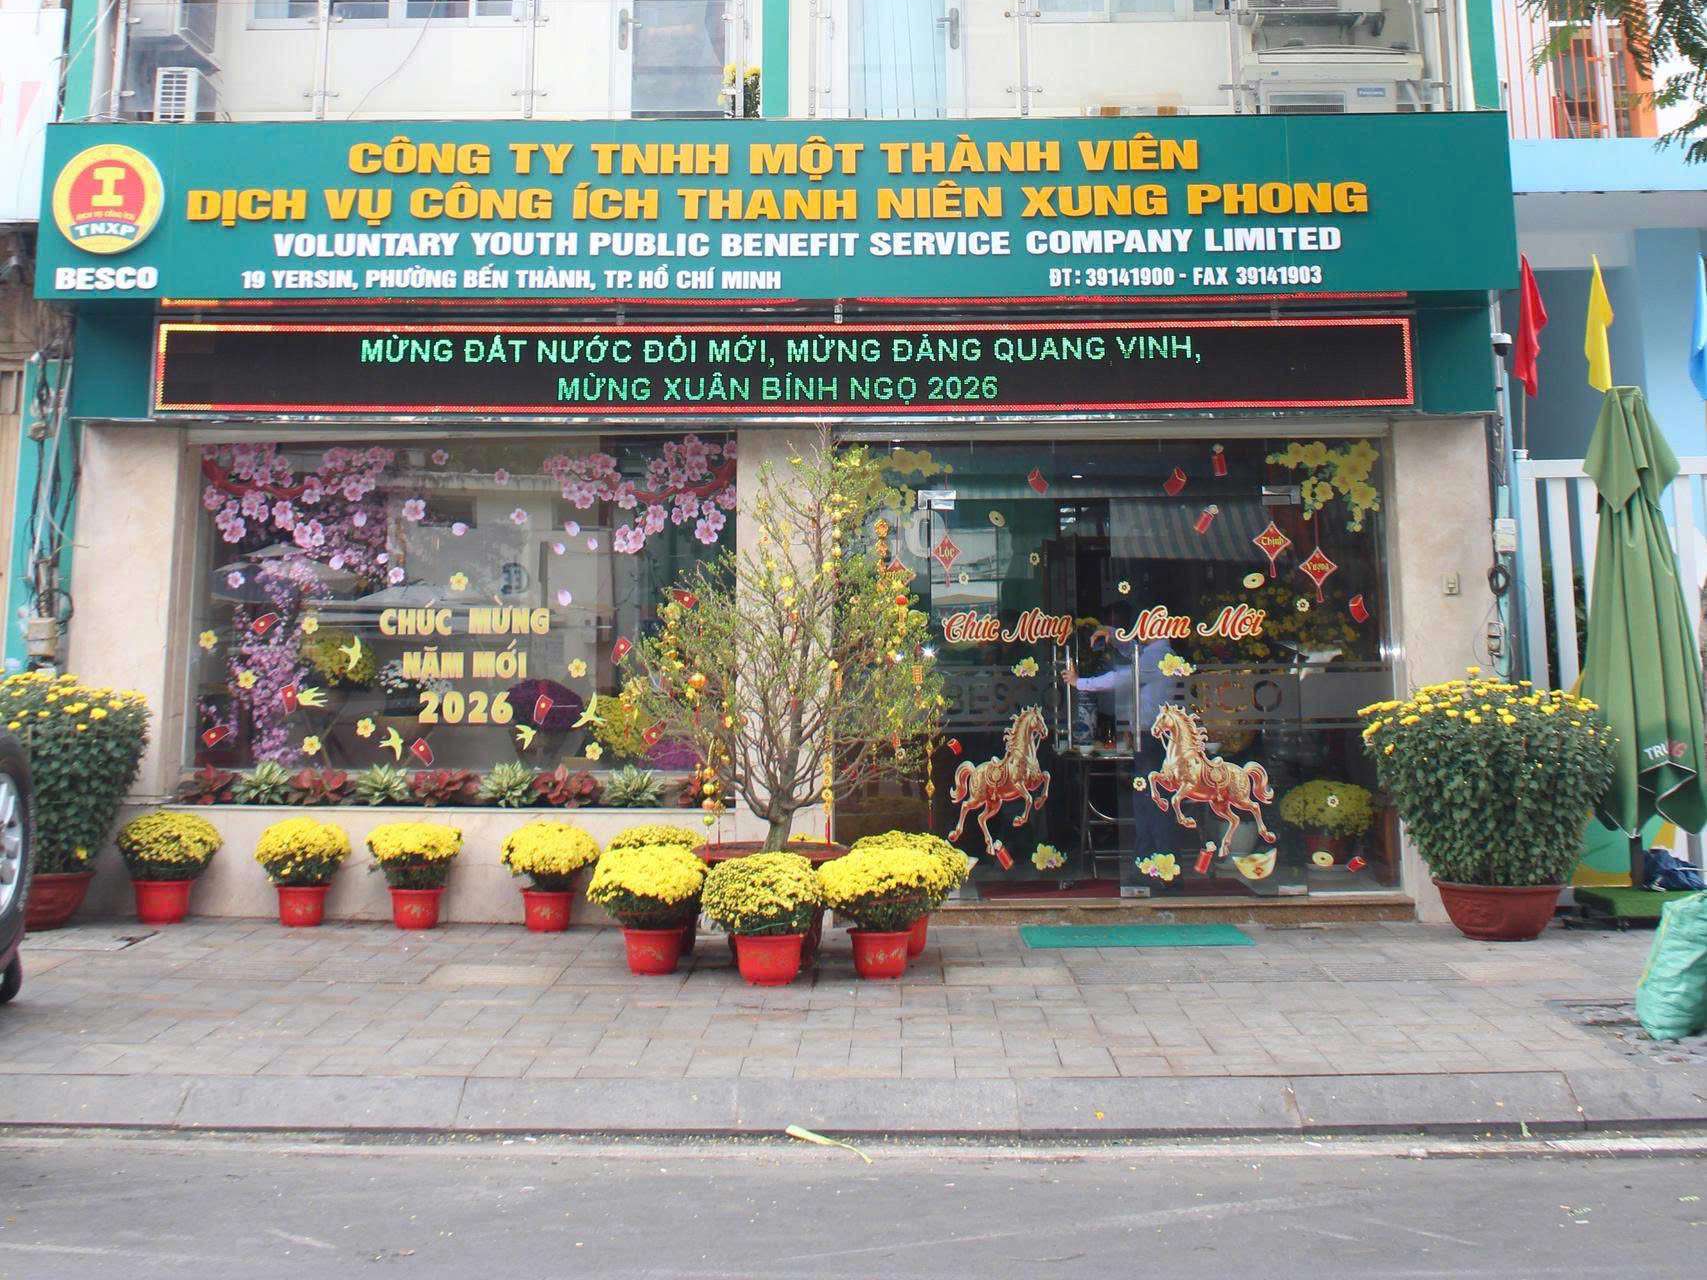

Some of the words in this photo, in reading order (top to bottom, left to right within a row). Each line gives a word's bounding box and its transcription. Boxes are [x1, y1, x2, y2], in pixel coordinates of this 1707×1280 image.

[349, 136, 490, 175] CÔNG
[511, 143, 570, 174] TY
[591, 143, 729, 174] TNHH
[750, 136, 864, 181] MỘT
[880, 134, 1060, 173] THÀNH
[1079, 132, 1199, 171] VIÊN
[187, 189, 307, 227] DỊCH
[325, 188, 392, 227] VỤ
[410, 181, 553, 220] CÔNG
[573, 182, 659, 220] ÍCH
[678, 187, 858, 220] THANH
[877, 180, 1002, 220] NIÊN
[1022, 184, 1168, 218] XUNG
[1187, 181, 1369, 215] PHONG
[74, 222, 136, 237] TNXP
[273, 232, 460, 258] VOLUNTARY
[470, 231, 579, 257] YOUTH
[589, 232, 711, 257] PUBLIC
[721, 232, 860, 257] BENEFIT
[869, 231, 1011, 256] SERVICE
[1026, 228, 1193, 255] COMPANY
[1205, 226, 1342, 252] LIMITED
[55, 266, 159, 291] BESCO
[241, 270, 265, 289] 19
[272, 269, 359, 292] YERSIN,
[365, 265, 457, 289] PHƯỜNG
[463, 263, 509, 289] BẾN
[515, 266, 596, 292] THÀNH,
[603, 270, 633, 289] TP.
[638, 263, 669, 289] HỒ
[676, 266, 715, 289] CHÍ
[721, 270, 781, 290] MINH
[1085, 267, 1175, 287] 39141900
[1193, 266, 1229, 286] FAX
[1236, 265, 1323, 285] 39141903
[361, 334, 454, 363] MỪNG
[537, 334, 632, 363] NƯỚC
[708, 334, 775, 368] MỚI,
[787, 334, 881, 363] MỪNG
[891, 333, 982, 362] ĐẢNG
[993, 336, 1106, 363] QUANG
[1115, 335, 1201, 364] VINH,
[557, 372, 651, 401] MỪNG
[663, 371, 750, 401] XUÂN
[761, 372, 838, 401] BÍNH
[850, 376, 917, 405] NGỌ
[927, 375, 998, 400] 2026
[379, 598, 452, 636] CHÚC
[468, 594, 550, 635] MỪNG
[942, 610, 1000, 643] Chúc
[1197, 603, 1266, 640] Mới
[402, 646, 464, 679] NĂM
[472, 639, 527, 679] MỚI
[418, 691, 513, 724] 2026
